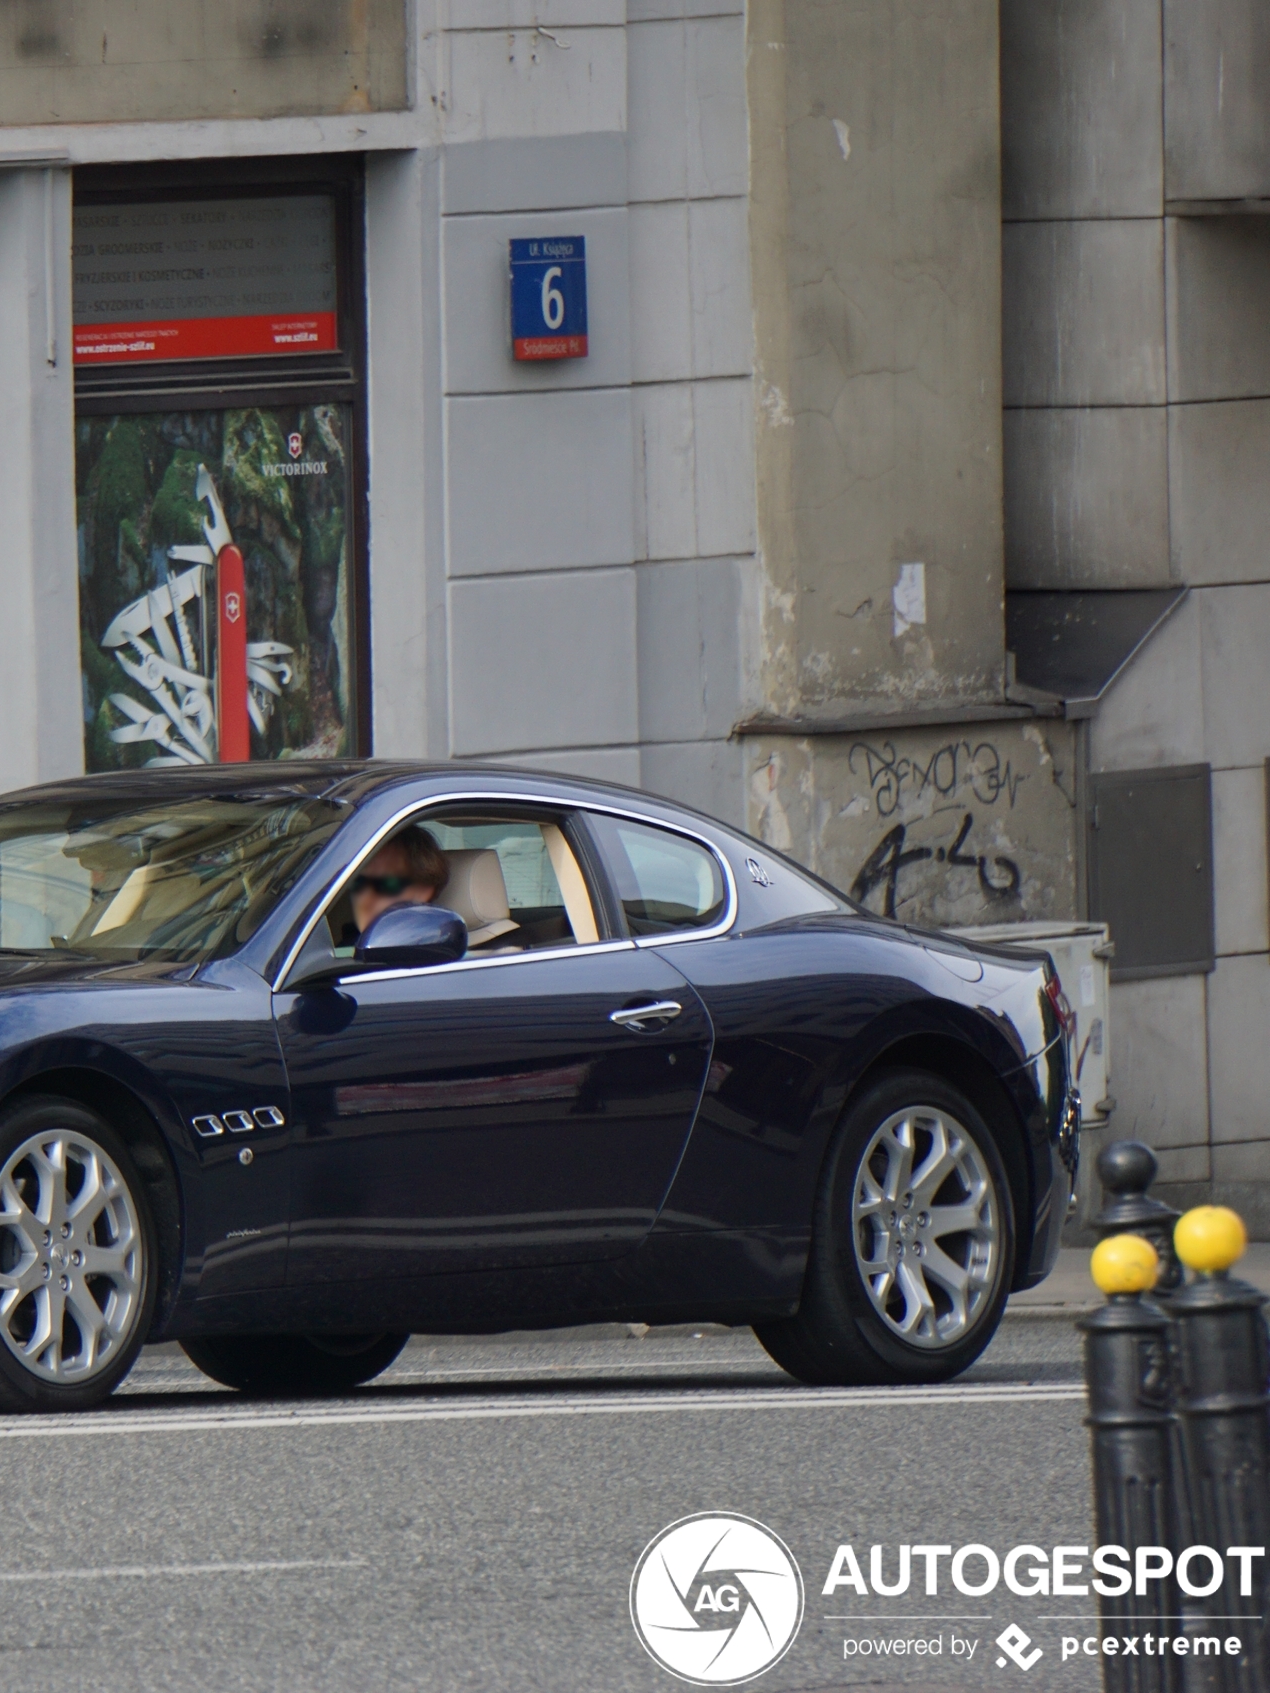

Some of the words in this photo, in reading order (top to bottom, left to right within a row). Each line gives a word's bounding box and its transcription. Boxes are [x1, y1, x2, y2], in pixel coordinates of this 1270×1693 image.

[139, 266, 205, 283] KOSMETYCZNE
[542, 266, 565, 330] 6
[274, 331, 319, 344] www.szlif.eu
[261, 461, 329, 477] VICTORINOX
